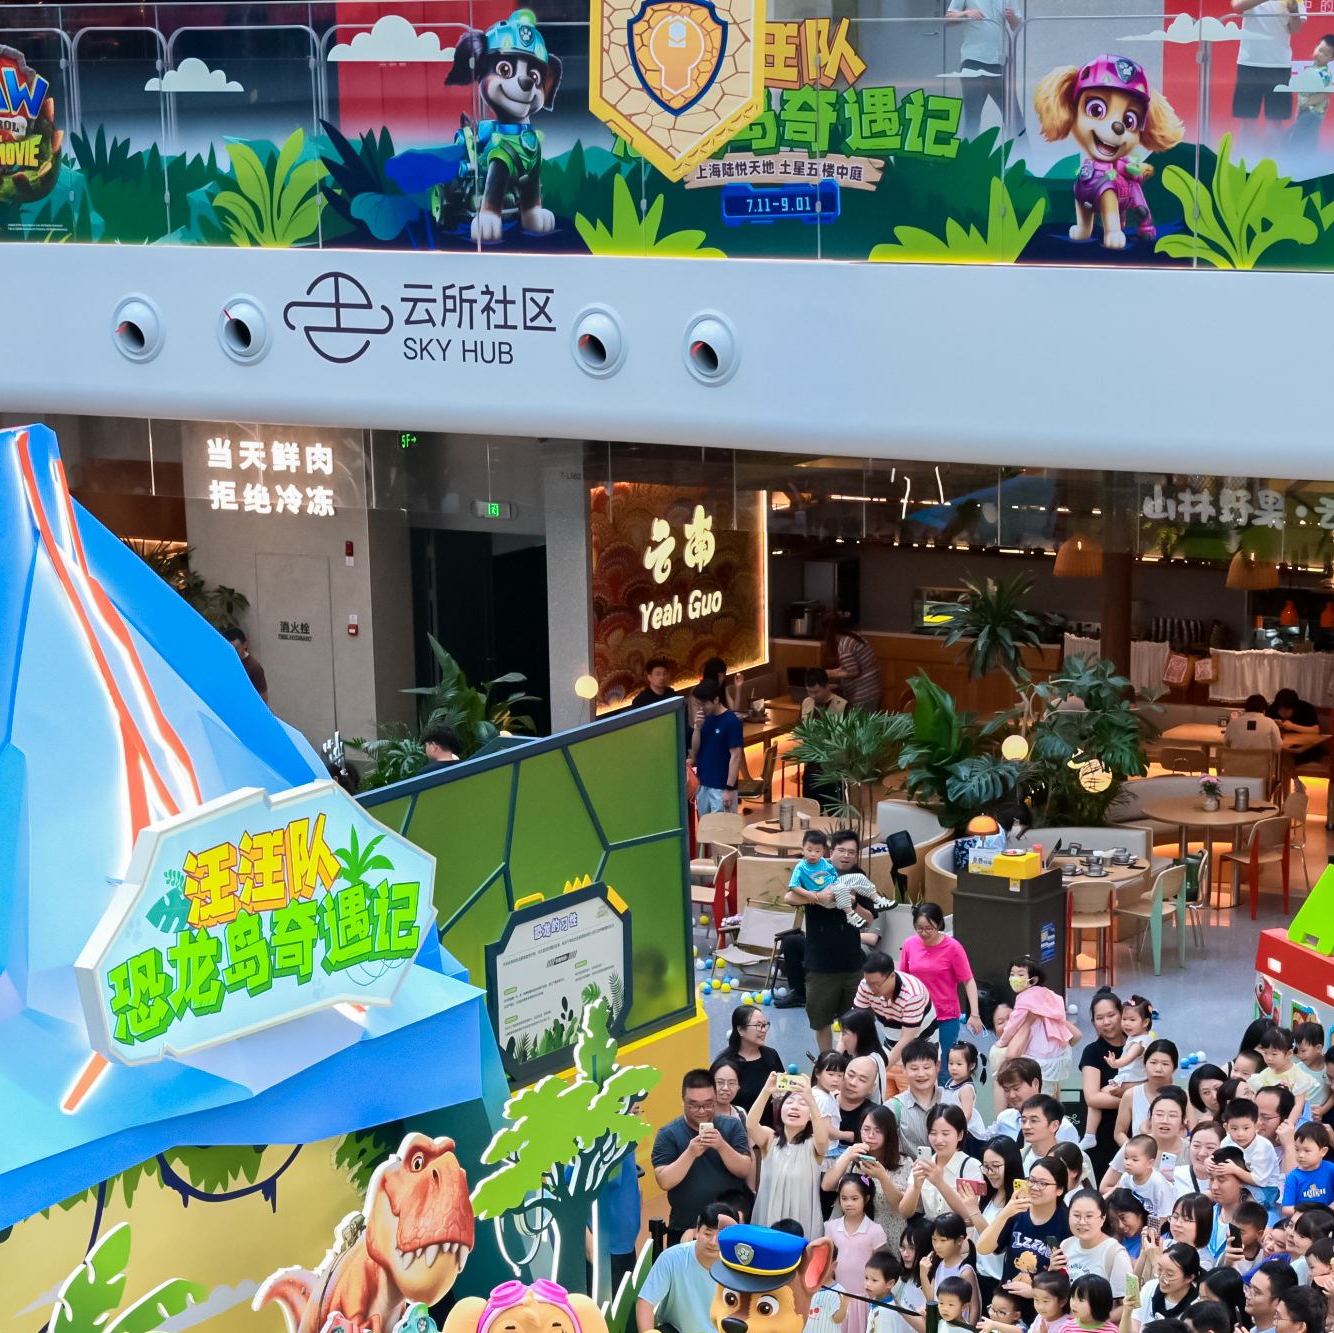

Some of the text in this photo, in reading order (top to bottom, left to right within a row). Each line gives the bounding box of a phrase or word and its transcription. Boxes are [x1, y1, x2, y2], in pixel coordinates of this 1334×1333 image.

[763, 18, 868, 88] 汪队
[758, 84, 965, 162] 岛奇遇记
[694, 159, 864, 184] 上海陆悦天地 土星五楼中庭
[746, 196, 812, 215] 7.11-9.01
[400, 283, 557, 331] 云所社区
[403, 336, 514, 365] SKY HUB
[206, 437, 333, 475] 当天鲜肉
[209, 479, 335, 517] 拒绝冷冻
[279, 620, 311, 635] 消火栓
[639, 589, 723, 633] Yeah Guo
[196, 821, 376, 956] 汪汪队
[533, 911, 579, 941] 恐龙的习性
[110, 880, 463, 1086] 恐龙岛奇遇记
